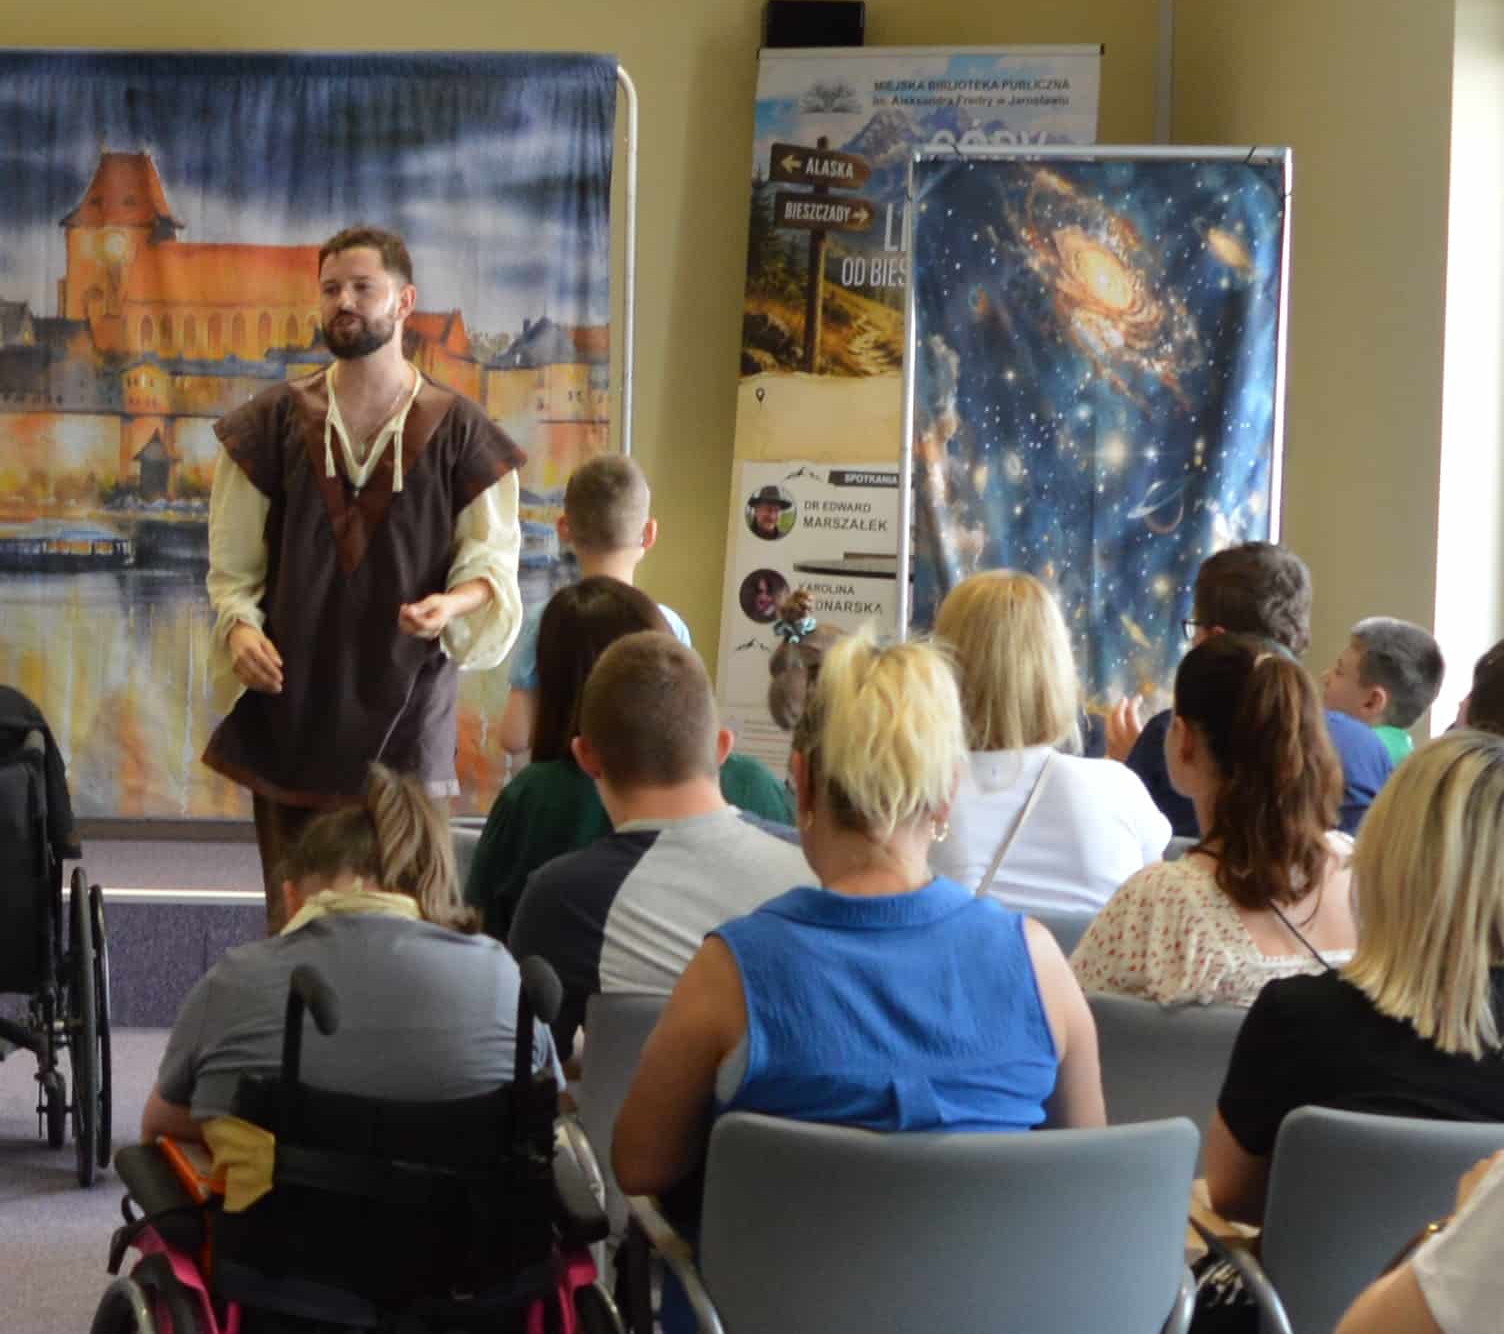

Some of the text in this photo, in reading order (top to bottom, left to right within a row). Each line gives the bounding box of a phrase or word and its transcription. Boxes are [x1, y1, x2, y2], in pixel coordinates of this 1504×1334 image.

[927, 79, 999, 91] BIBLIOTEKA
[1001, 77, 1071, 91] PUBLICZNA
[804, 156, 855, 180] ALASKA
[784, 201, 852, 225] BIESZCZADY
[842, 256, 866, 287] OD
[803, 499, 872, 514] DR EDWARD
[802, 516, 889, 533] MARSZAŁEK
